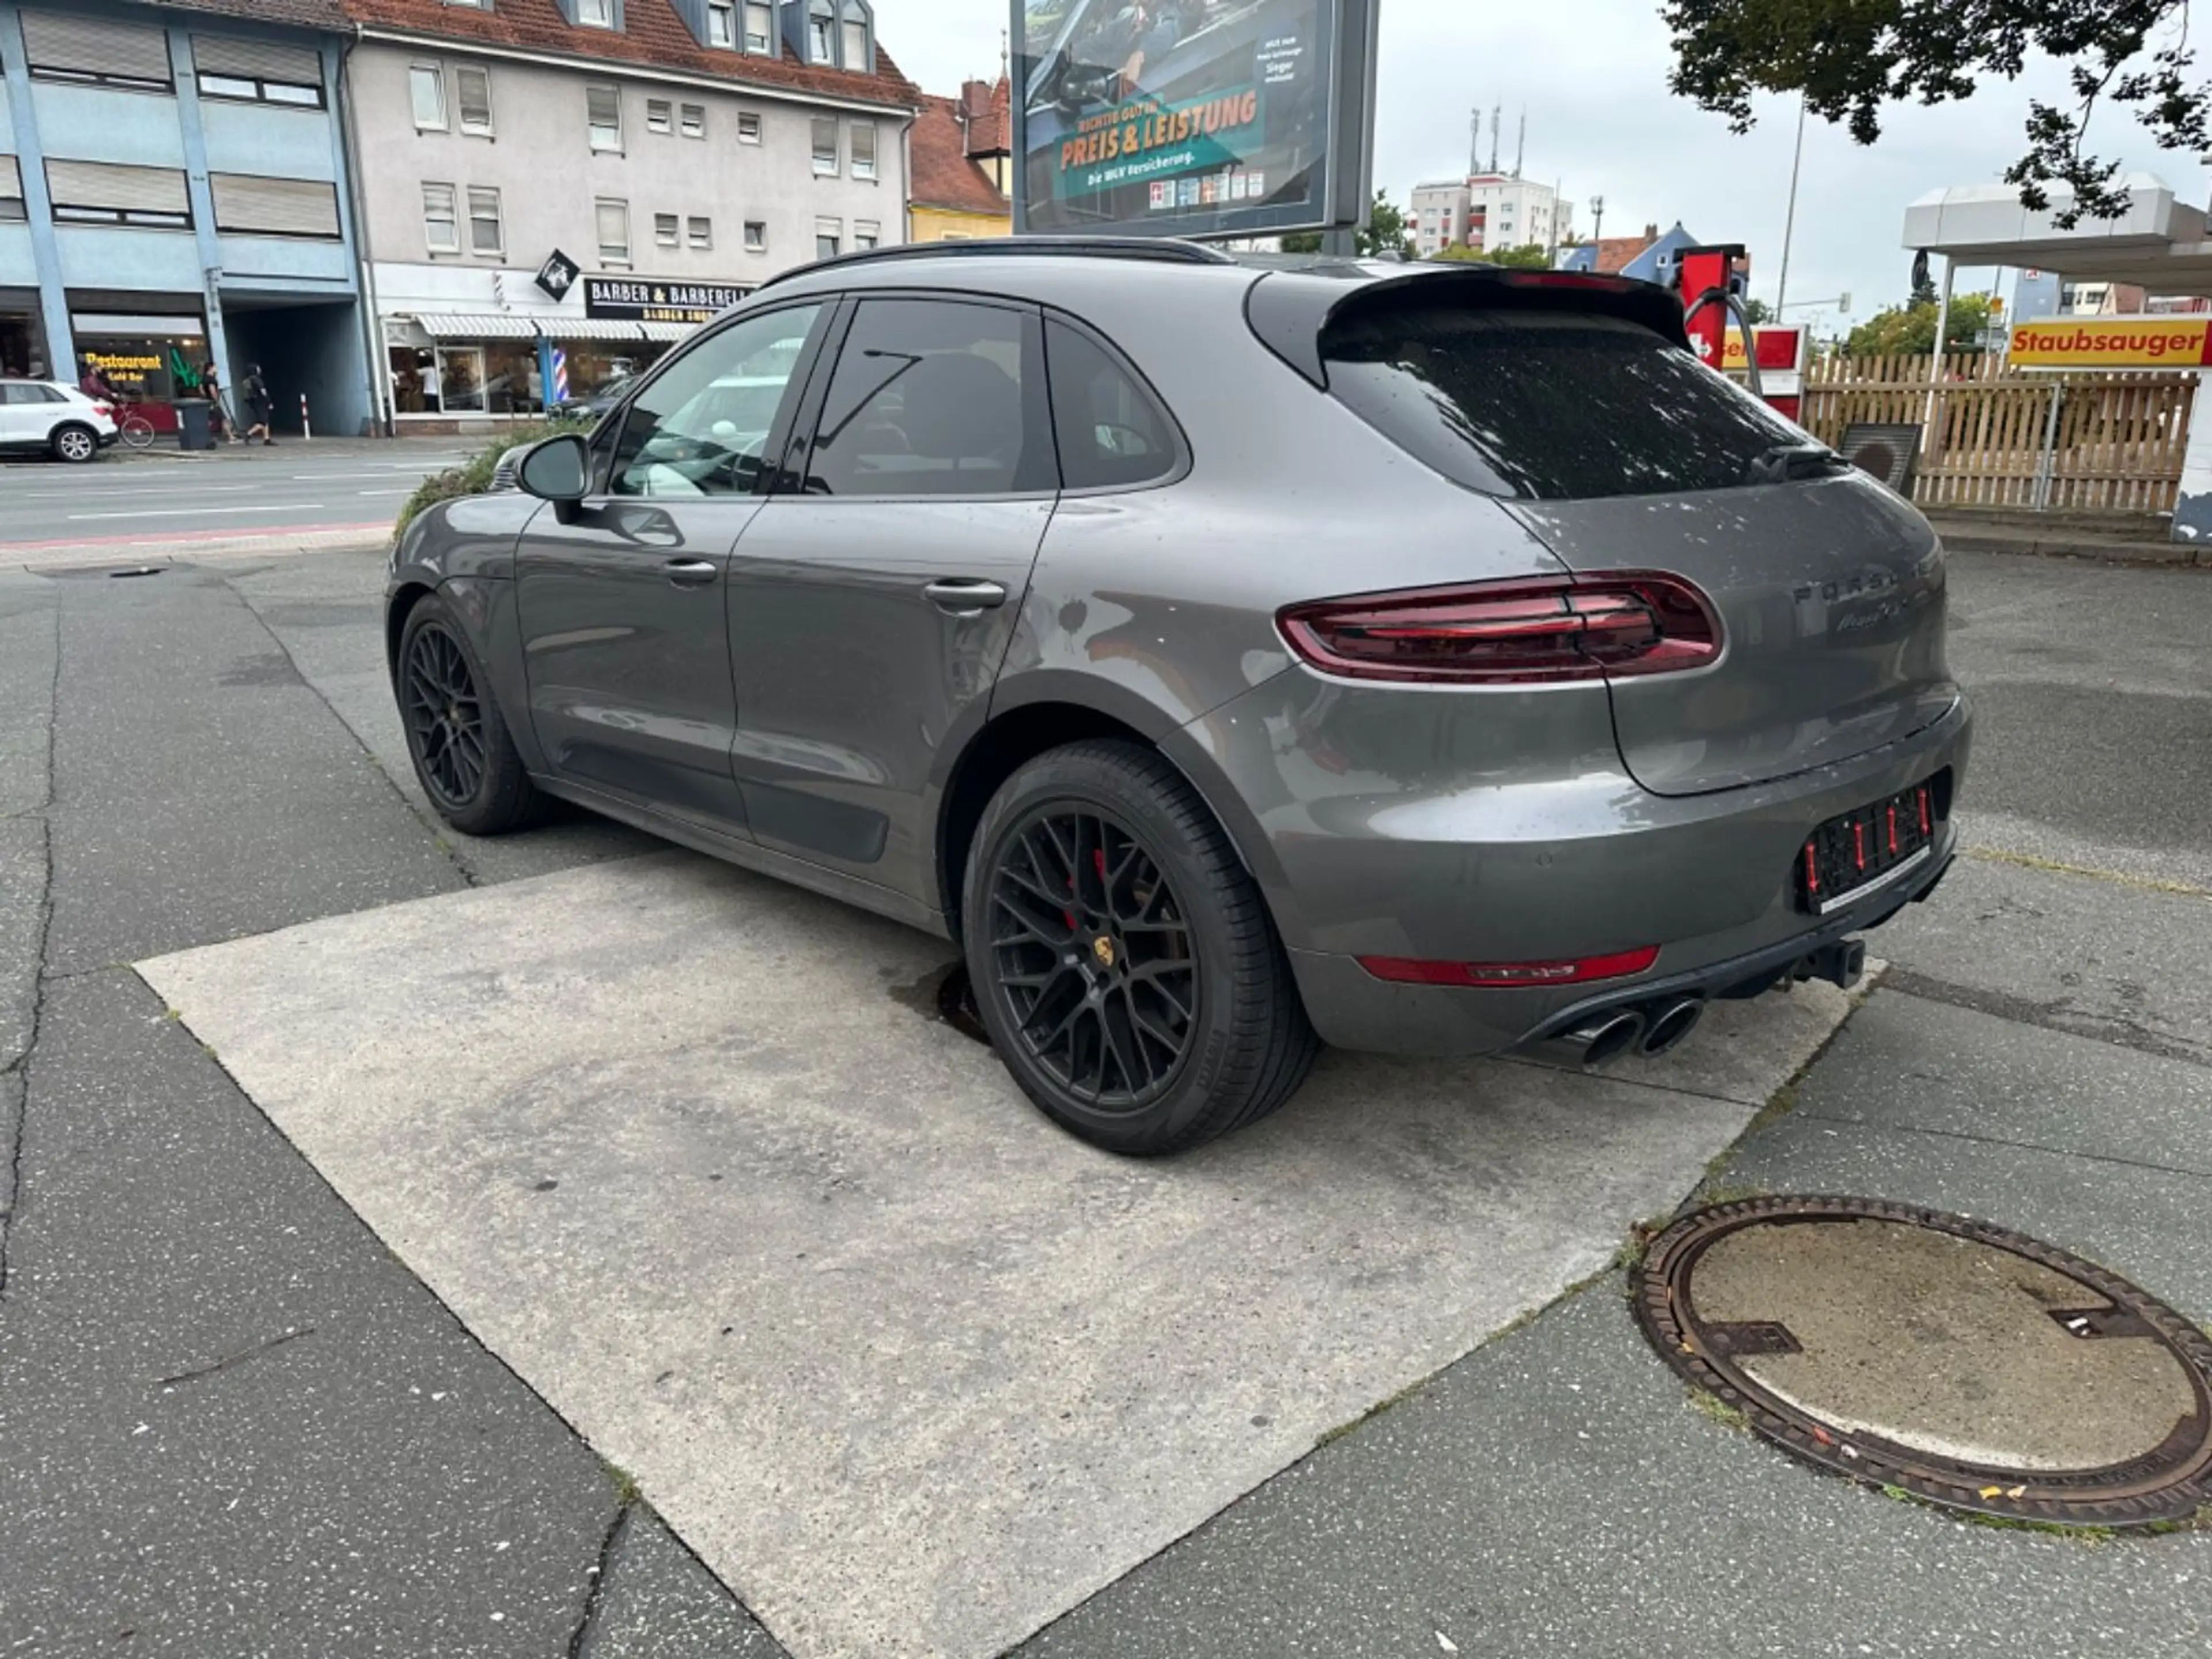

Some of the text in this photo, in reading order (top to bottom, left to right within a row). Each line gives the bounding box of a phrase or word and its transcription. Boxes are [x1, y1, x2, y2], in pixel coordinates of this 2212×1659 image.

[1061, 90, 1257, 169] PREIS & LEISTUNG
[591, 282, 649, 302] BARBER
[654, 288, 665, 302] &
[2012, 328, 2204, 357] Staubsauger
[85, 352, 162, 370] Restaurant
